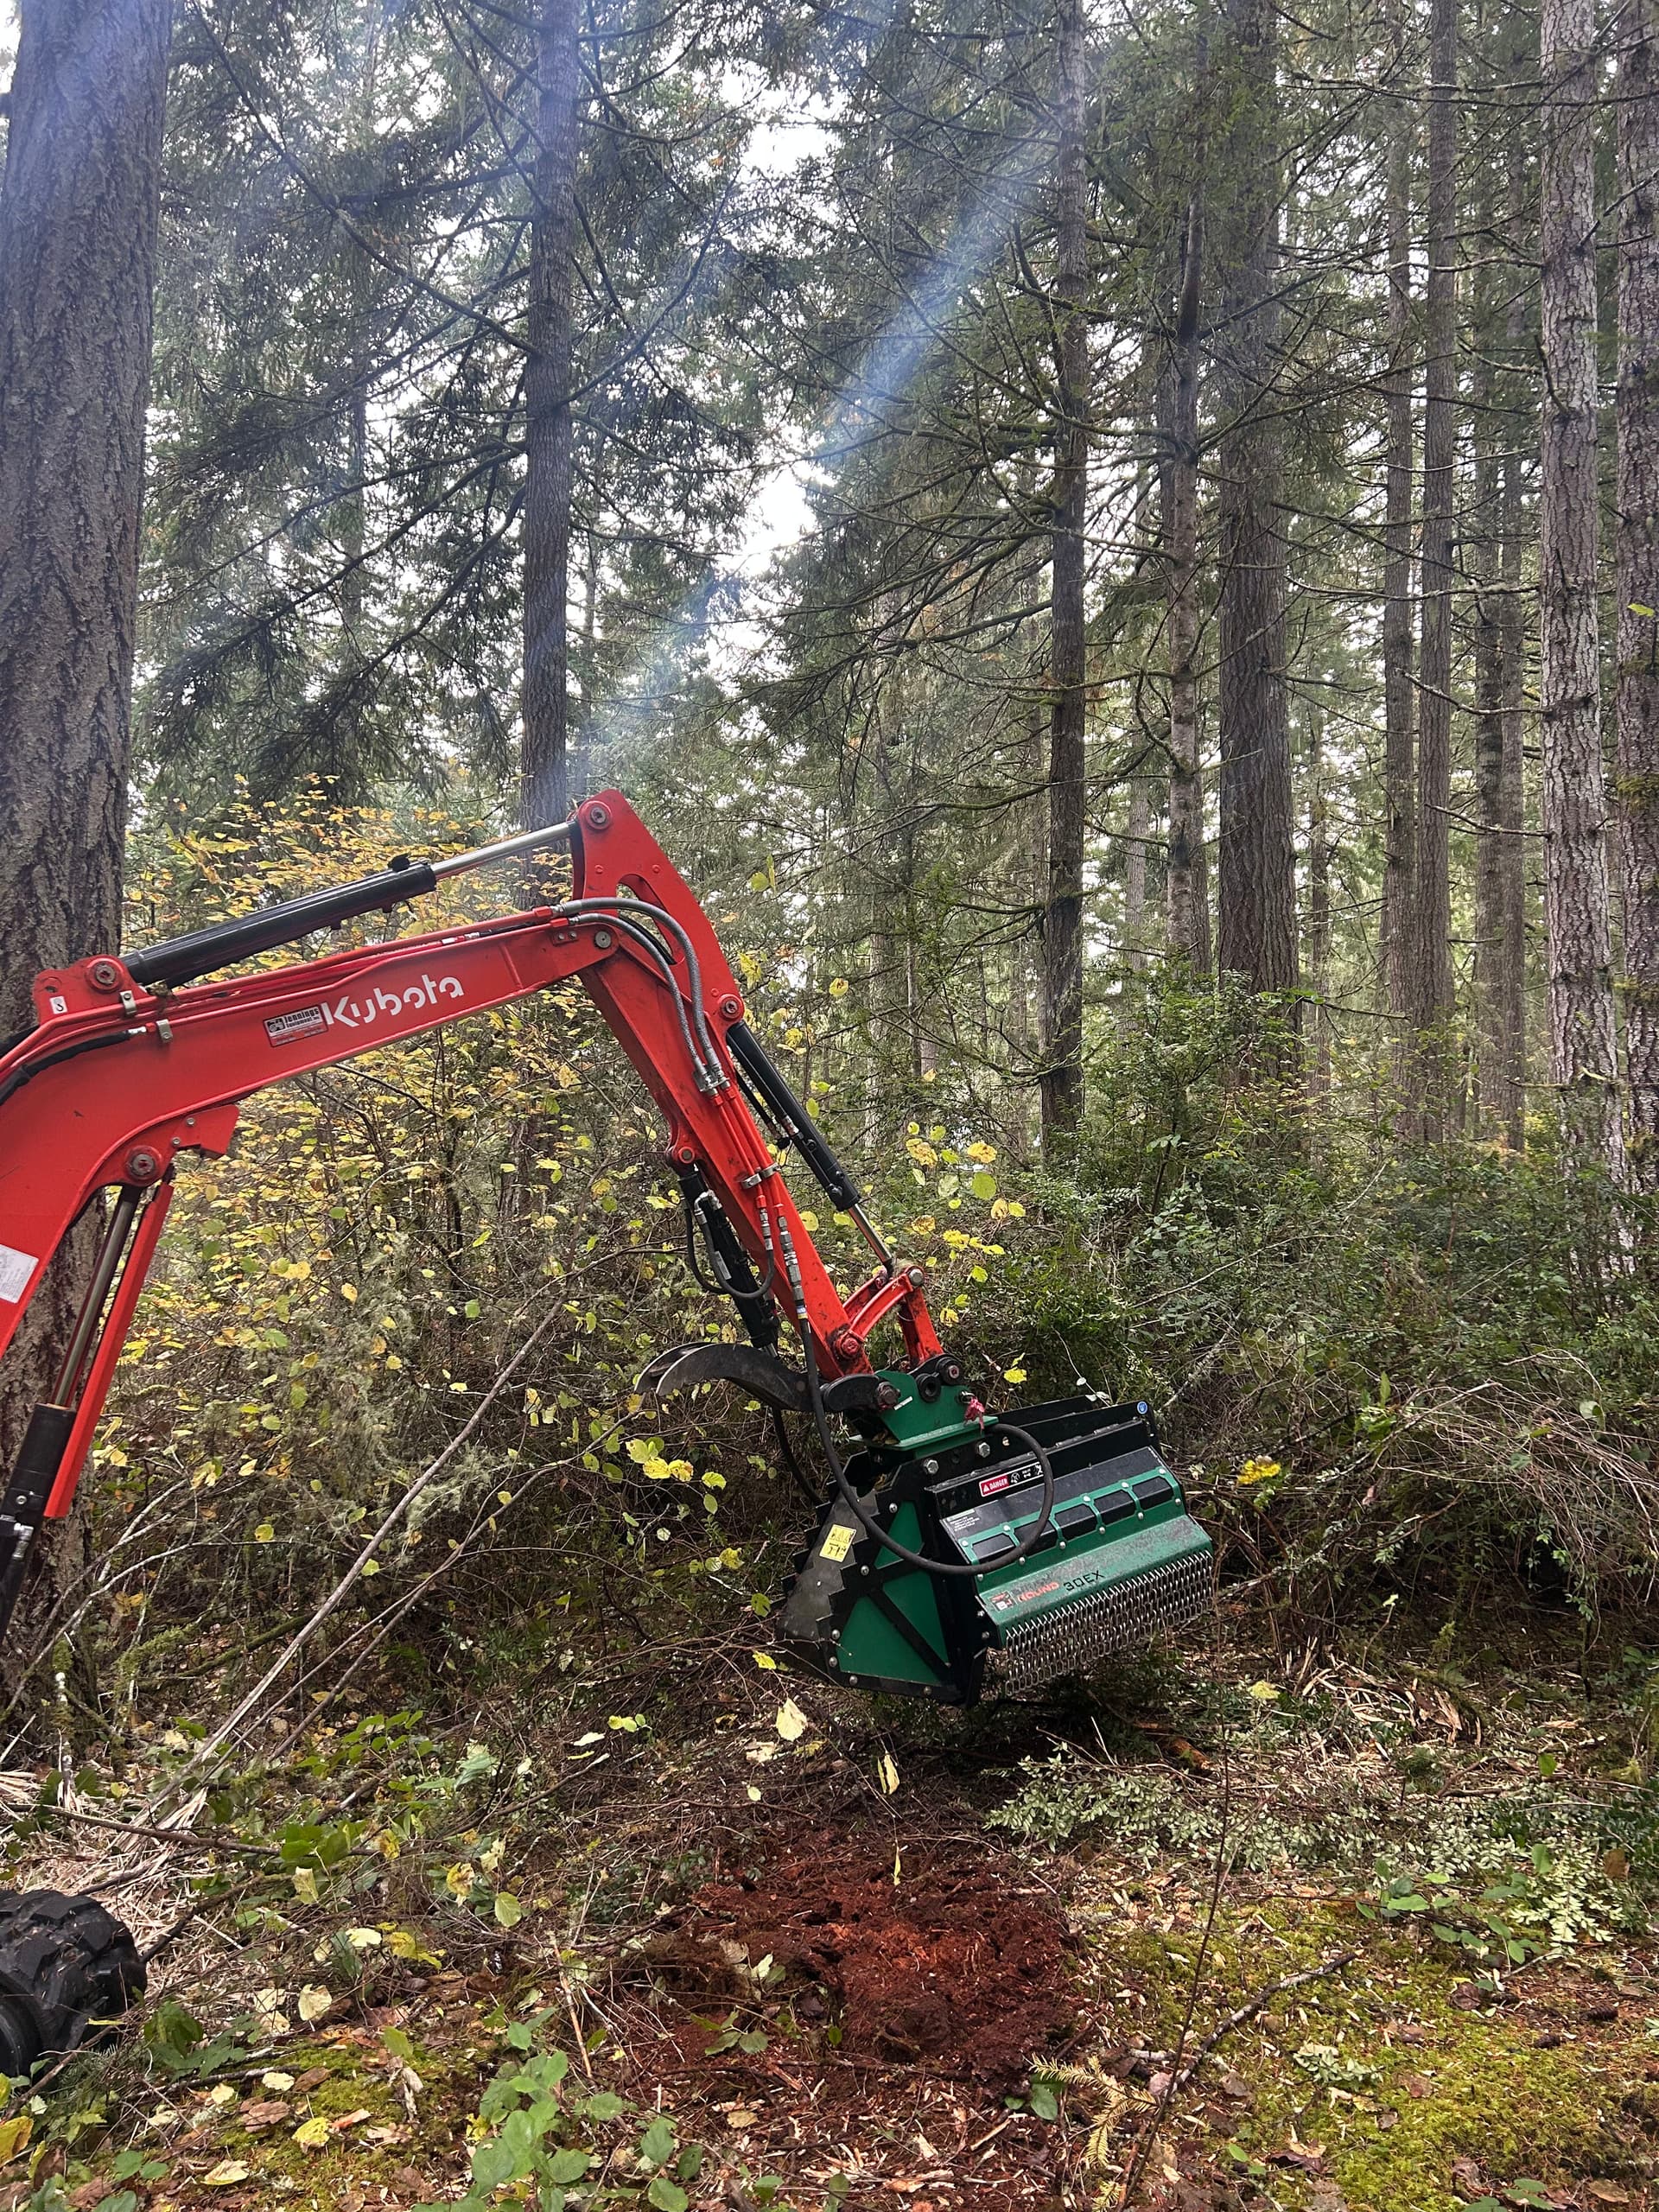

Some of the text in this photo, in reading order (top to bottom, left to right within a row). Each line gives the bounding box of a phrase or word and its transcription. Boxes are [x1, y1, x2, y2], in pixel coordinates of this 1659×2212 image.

[320, 974, 465, 1028] Kubota
[988, 1478, 1009, 1491] DANGER
[1063, 1569, 1105, 1592] 30EX
